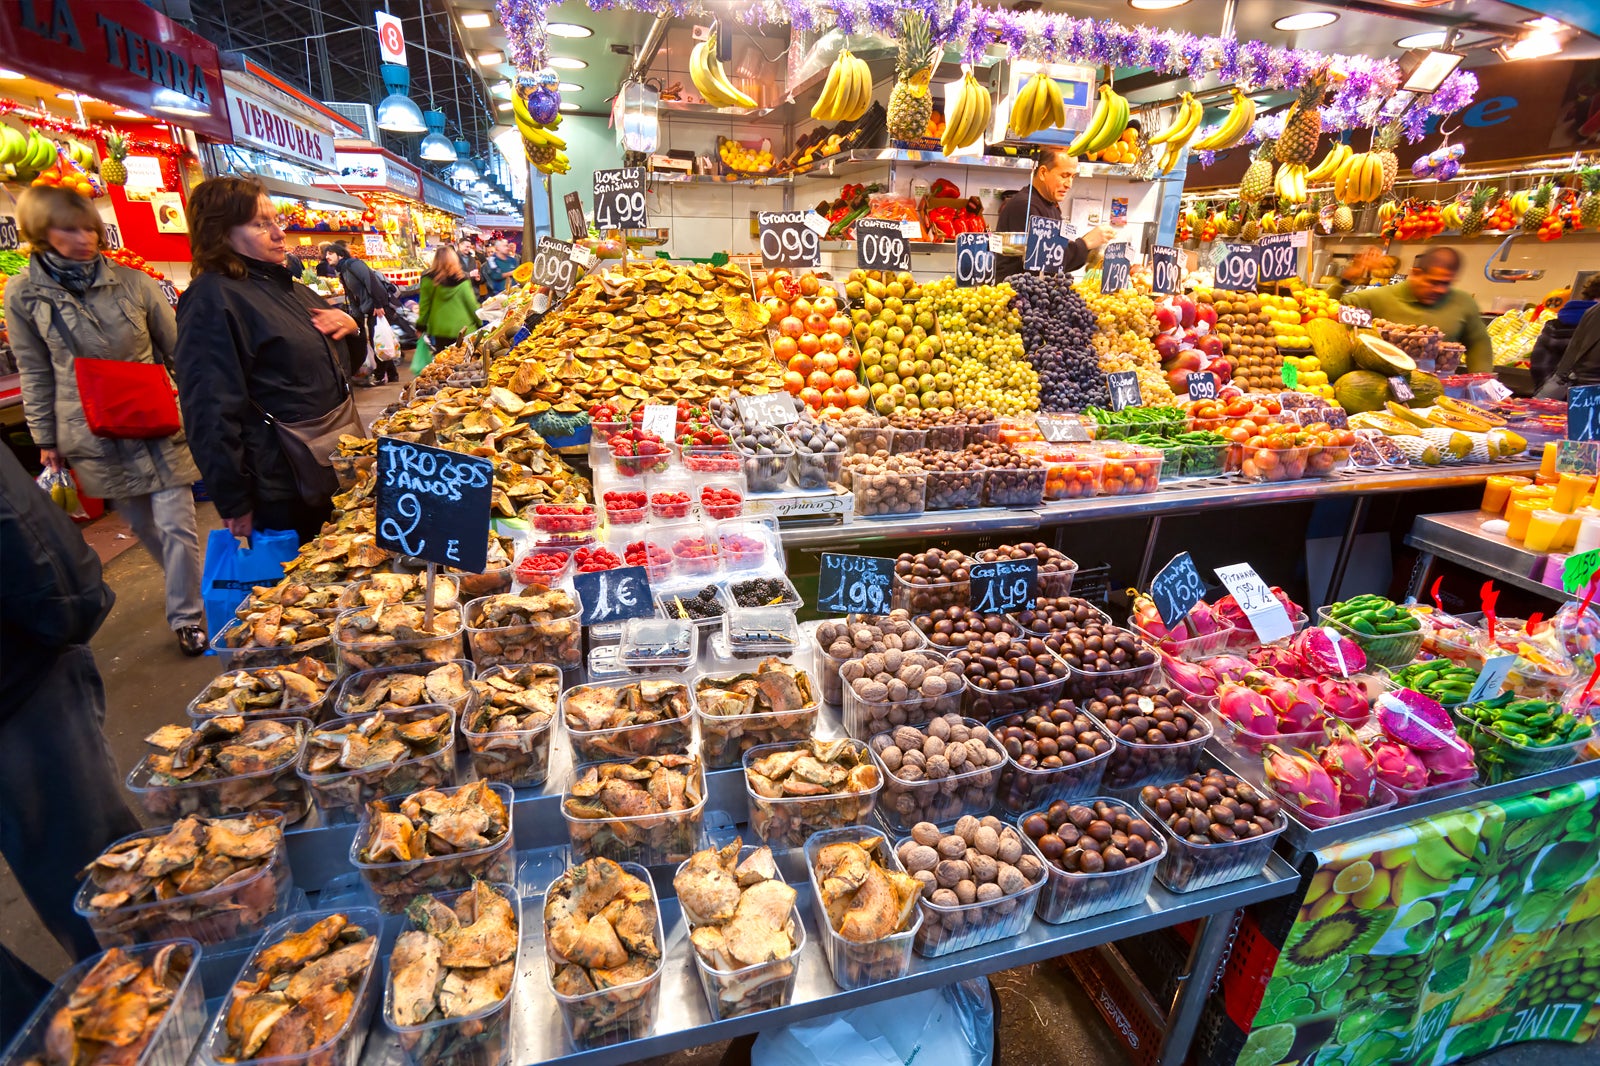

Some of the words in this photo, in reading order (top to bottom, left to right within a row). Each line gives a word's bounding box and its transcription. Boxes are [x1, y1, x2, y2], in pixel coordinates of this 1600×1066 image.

[18, 0, 86, 52] LA
[96, 13, 211, 105] TERRA
[387, 27, 399, 51] 8
[236, 96, 323, 161] VERDURAS
[760, 227, 818, 262] 0,99
[379, 441, 492, 488] TROZOS
[385, 469, 462, 500] SANOS
[380, 493, 425, 556] 2
[777, 498, 844, 515] Carmelo
[1501, 1003, 1583, 1045] LIME
